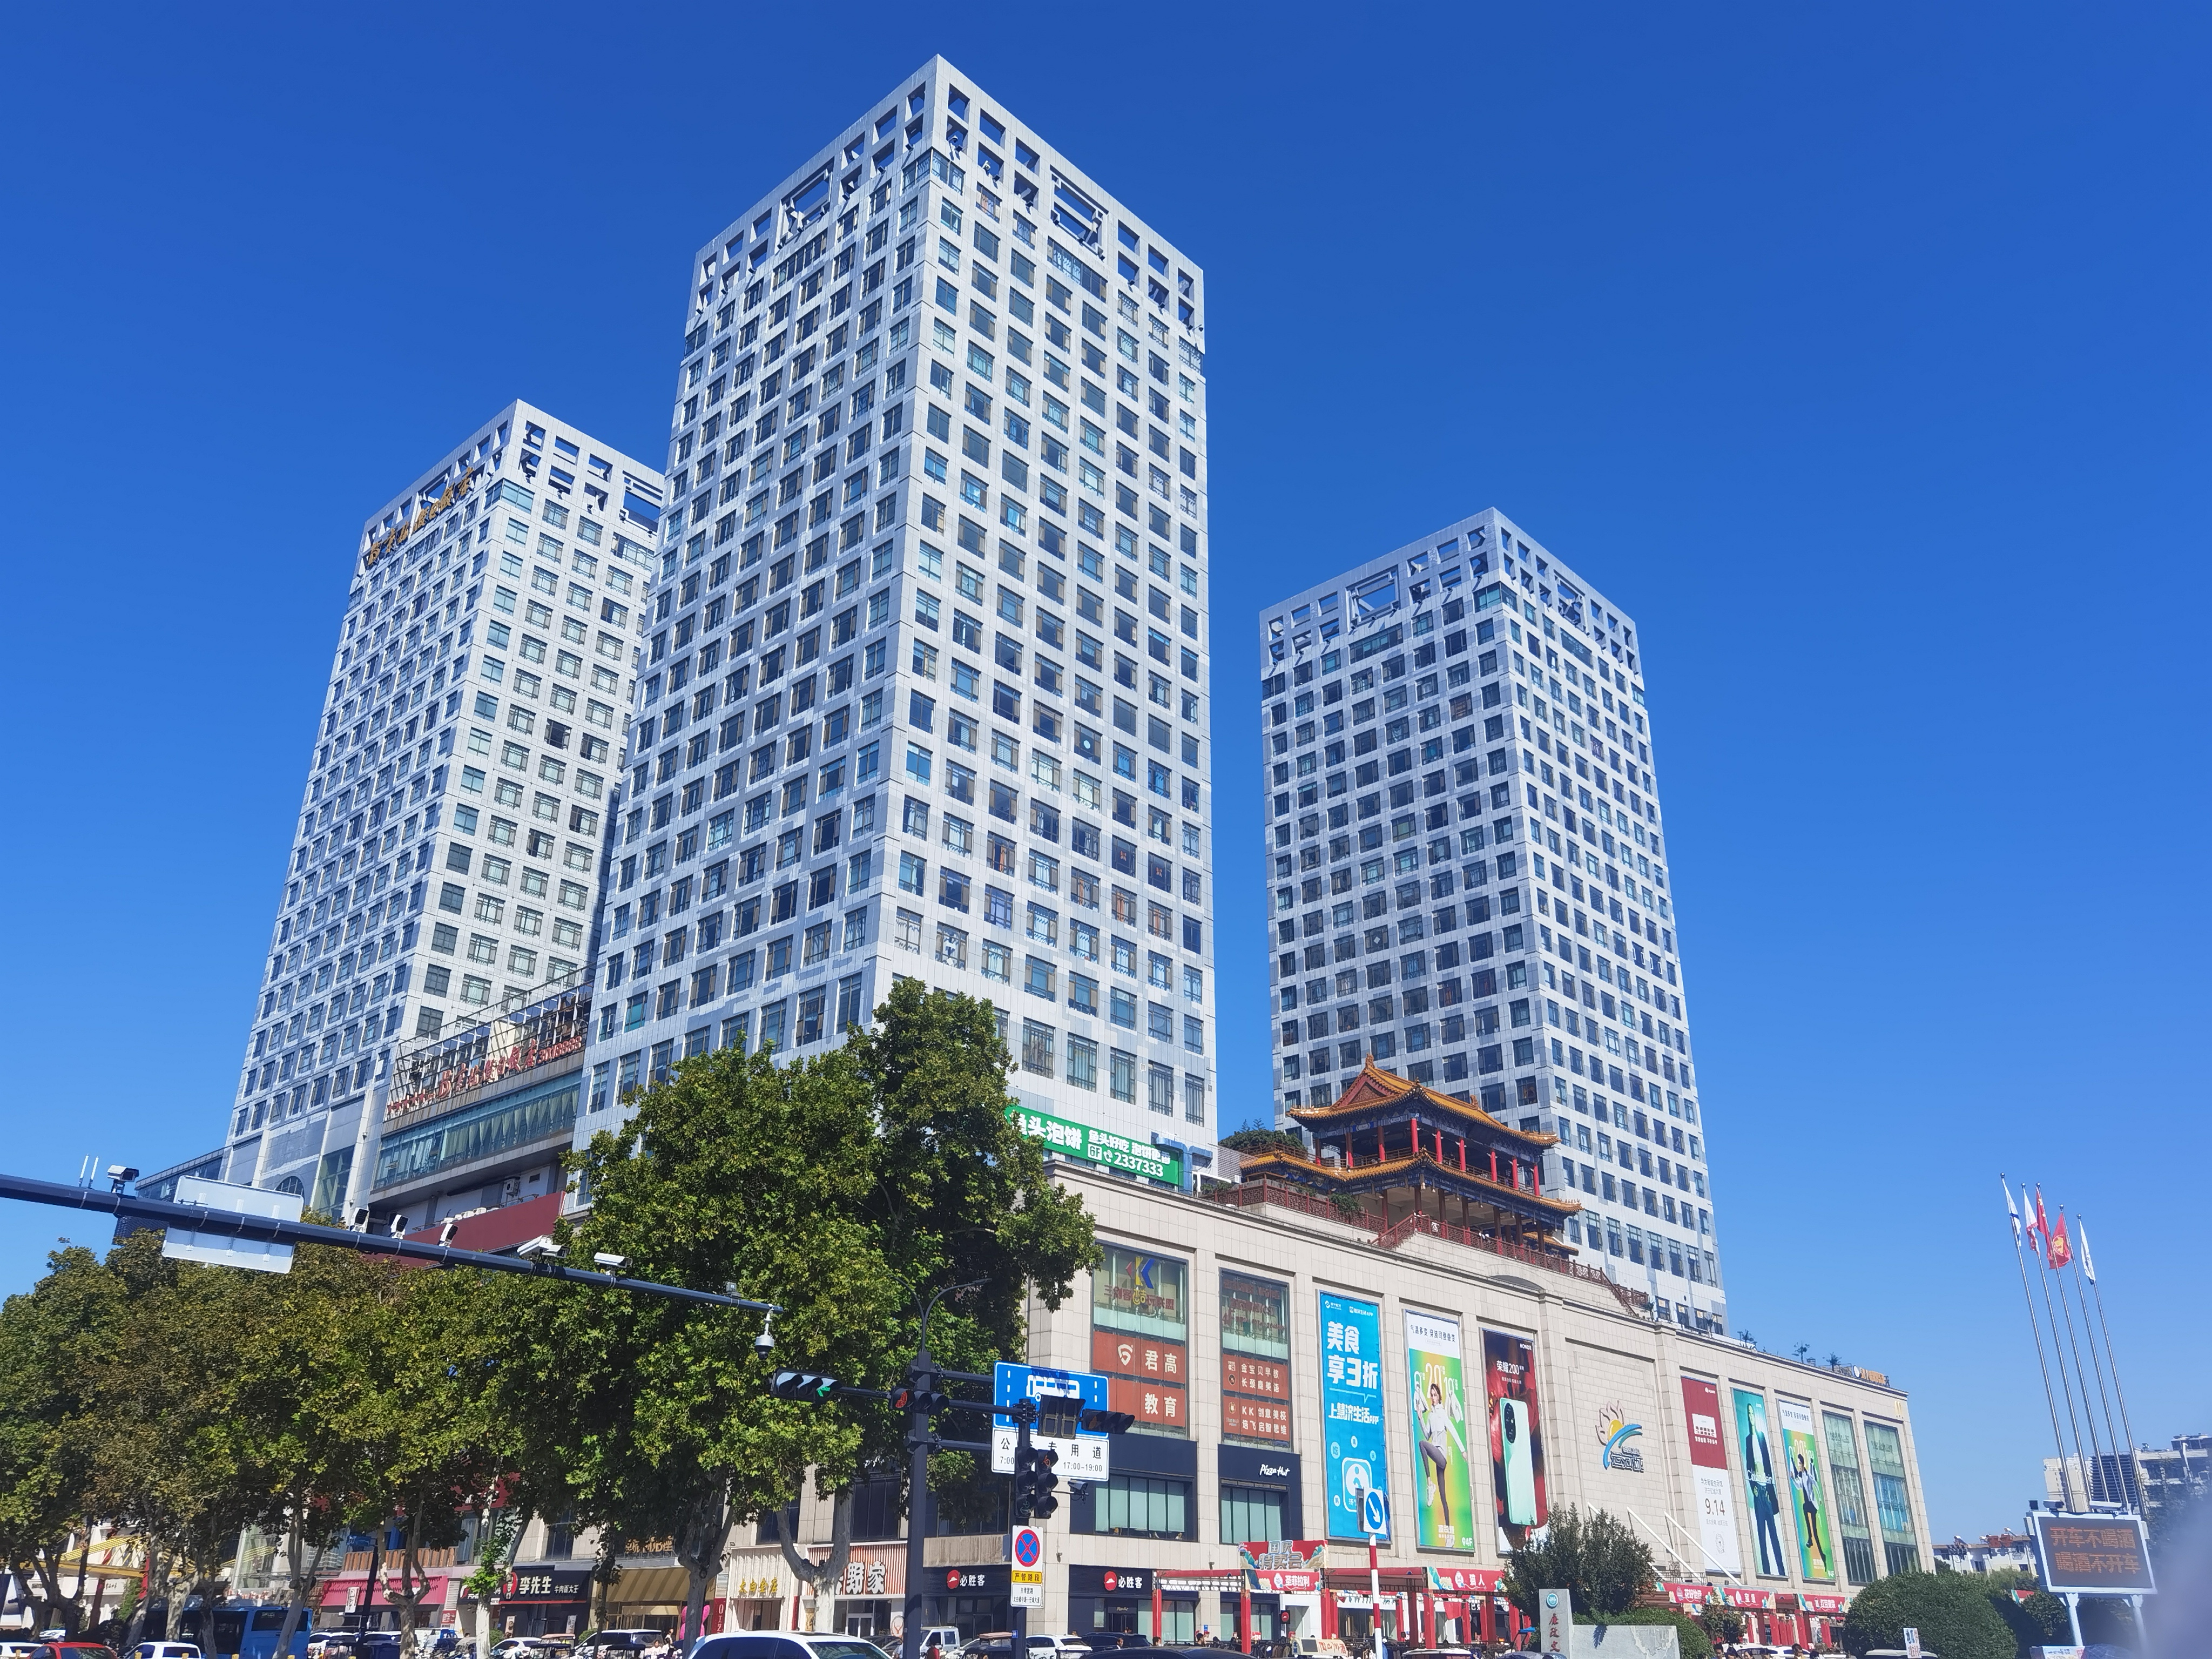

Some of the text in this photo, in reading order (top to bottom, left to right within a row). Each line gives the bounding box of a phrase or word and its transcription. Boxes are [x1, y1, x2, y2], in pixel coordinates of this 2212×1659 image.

[1088, 1129, 1171, 1165] 鱼头好吃 泡饼更香
[1090, 1145, 1163, 1177] 6F 2337333
[1327, 1321, 1360, 1354] 美食
[1410, 1325, 1428, 1337] 气温多变
[1144, 1350, 1177, 1374] 君高
[1242, 1363, 1280, 1379] 金宝贝早教
[1496, 1360, 1520, 1375] 荣耀200
[1327, 1354, 1378, 1390] 享3折
[1242, 1377, 1280, 1393] 长颈鹿美语
[1144, 1392, 1177, 1418] 教育
[1328, 1402, 1379, 1425] 上慧济生活APP
[1001, 1437, 1102, 1459] 公专用道
[1063, 1461, 1102, 1472] 17:00-19:00
[1259, 1464, 1290, 1476] Pizza Hut
[1705, 1498, 1725, 1516] 9.14
[1269, 1540, 1293, 1554] 国庆
[2049, 1527, 2136, 1549] 开车不喝酒
[1259, 1552, 1303, 1570] 特卖会
[2055, 1551, 2142, 1574] 喝酒不开车
[519, 1576, 579, 1594] 李先生 牛肉面大王
[835, 1560, 887, 1595] 野家
[960, 1574, 986, 1587] 必胜客
[1014, 1572, 1040, 1582] 严管路段
[1118, 1575, 1143, 1589] 必胜客
